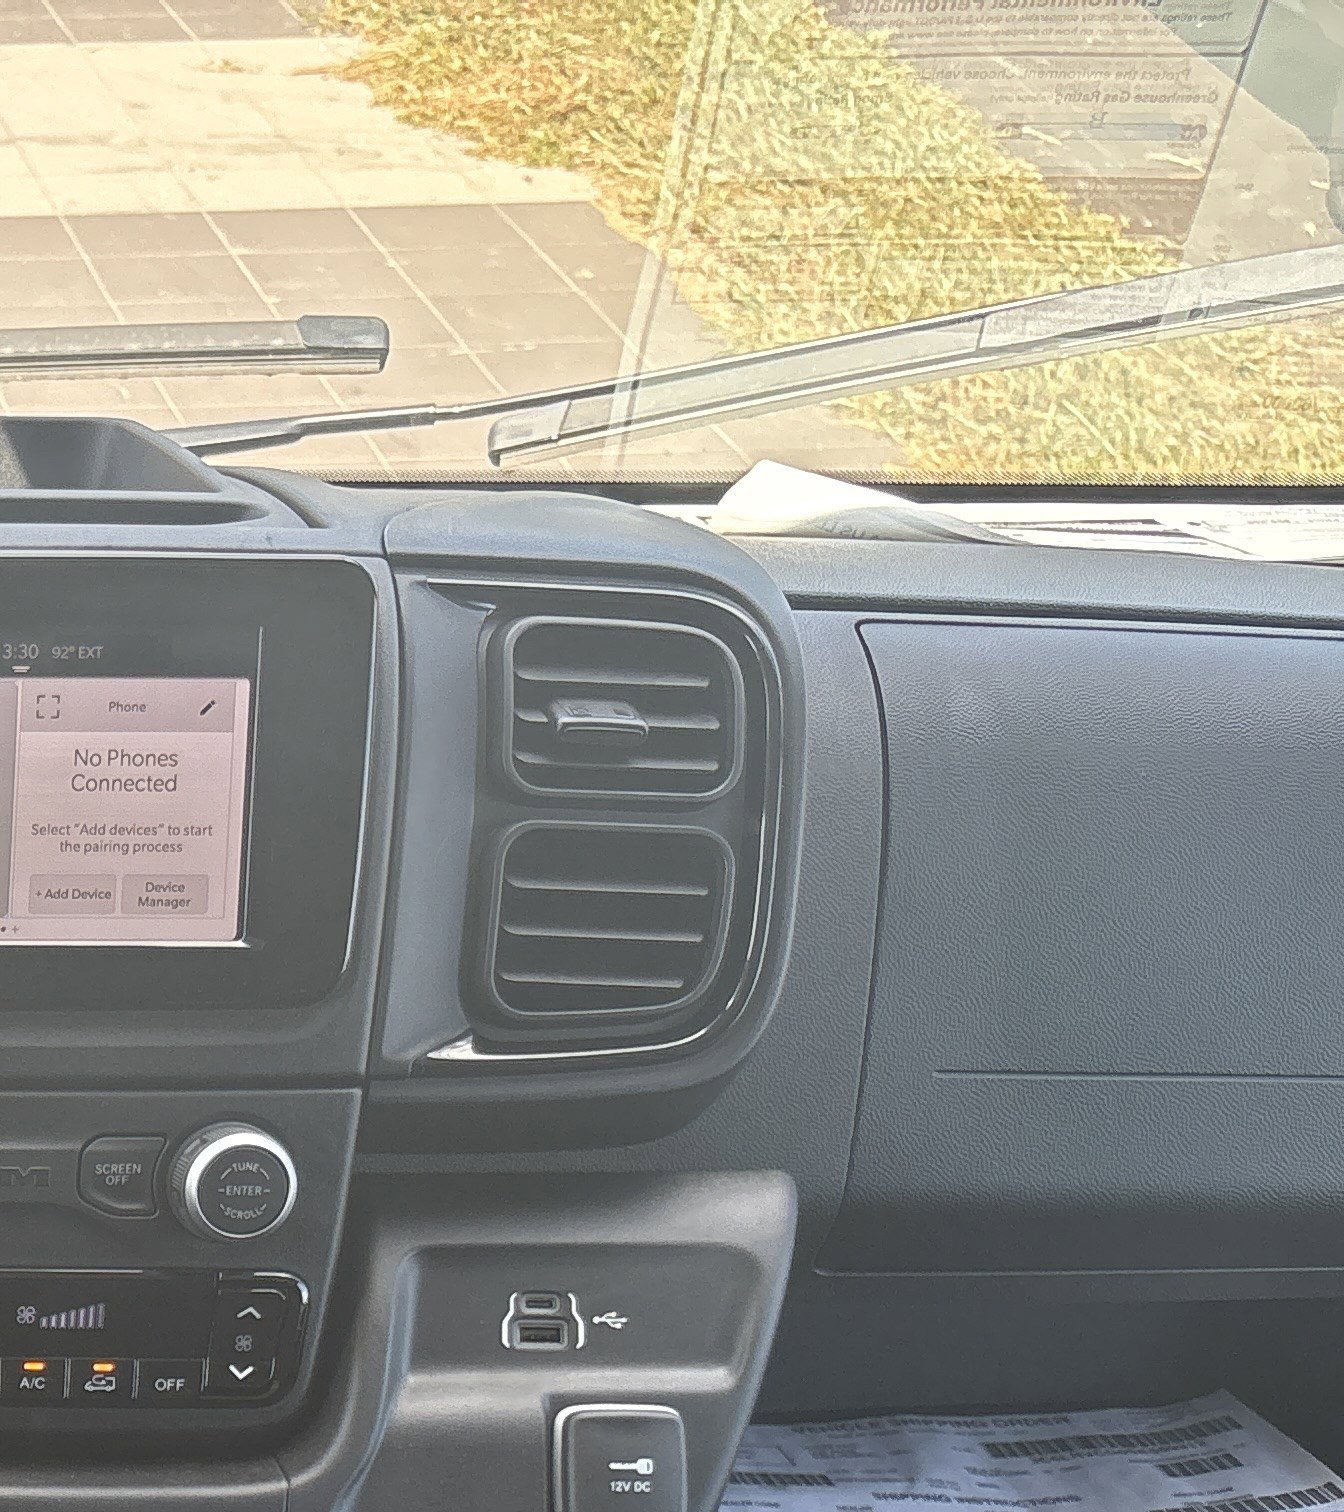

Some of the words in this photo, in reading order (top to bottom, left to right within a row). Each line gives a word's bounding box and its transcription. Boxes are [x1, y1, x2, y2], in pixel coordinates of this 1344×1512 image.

[2, 643, 39, 660] 3:30
[78, 646, 104, 660] EXT
[108, 701, 147, 713] Phone
[73, 748, 102, 768] No
[107, 748, 179, 768] Phones
[70, 773, 178, 793] Connected
[31, 824, 71, 837] Select
[73, 823, 107, 837] "Add
[109, 823, 165, 837] devices"
[167, 825, 180, 837] to
[183, 824, 213, 837] start
[59, 841, 81, 853] the
[84, 840, 129, 856] pairing
[132, 842, 183, 856] process
[44, 888, 69, 899] Add
[72, 888, 112, 900] Device
[145, 881, 185, 894] Device
[137, 896, 191, 909] Manager
[95, 1163, 142, 1176] SCREEN
[232, 1161, 260, 1174] TUNE
[105, 1175, 129, 1186] OFF
[225, 1185, 262, 1196] ENTER
[224, 1205, 263, 1221] SCROLL
[18, 1375, 46, 1391] A/C
[155, 1378, 186, 1392] OFF
[610, 1481, 631, 1493] 12V
[633, 1481, 651, 1493] DC
